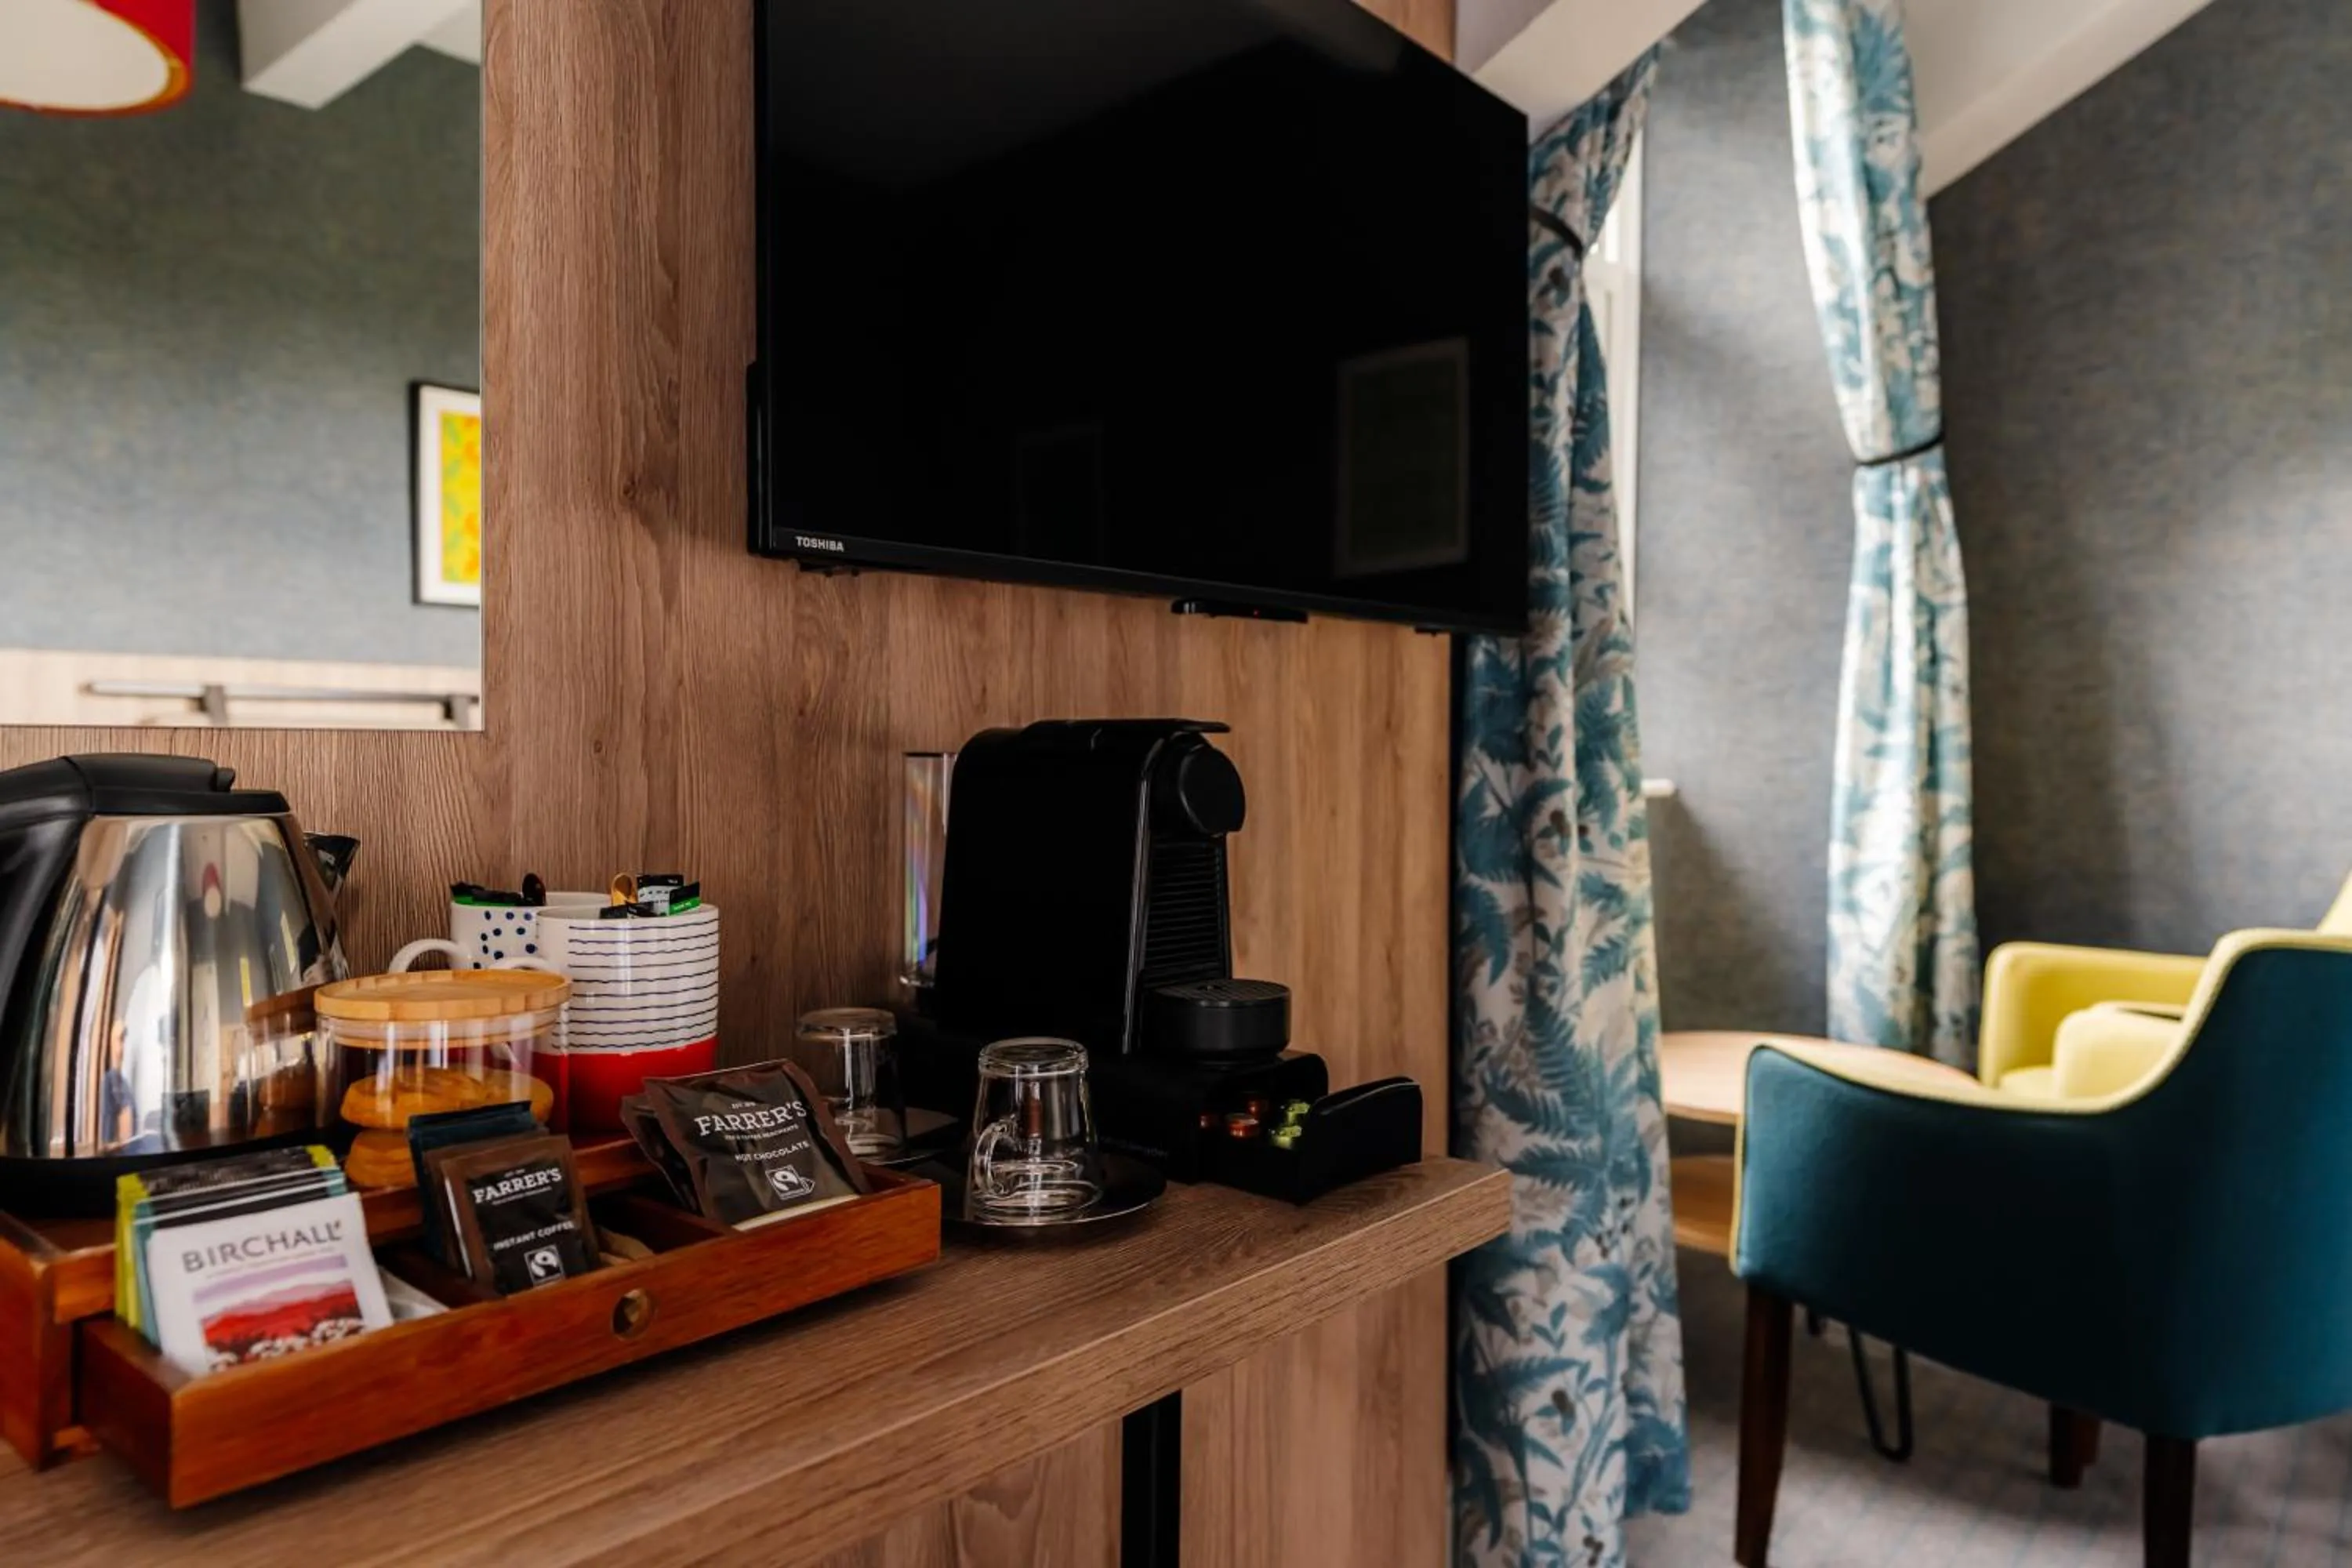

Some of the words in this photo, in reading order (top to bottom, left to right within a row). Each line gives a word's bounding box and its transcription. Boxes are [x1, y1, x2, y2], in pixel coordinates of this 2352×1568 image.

[795, 535, 844, 552] TOSHIBA
[694, 1101, 807, 1137] FARRER'S
[753, 1141, 810, 1160] CHOCOLATE
[473, 1167, 562, 1204] FARRER'S
[181, 1221, 343, 1272] BIRCHALL
[493, 1231, 536, 1250] INSTANT
[537, 1221, 575, 1238] COFFEE
